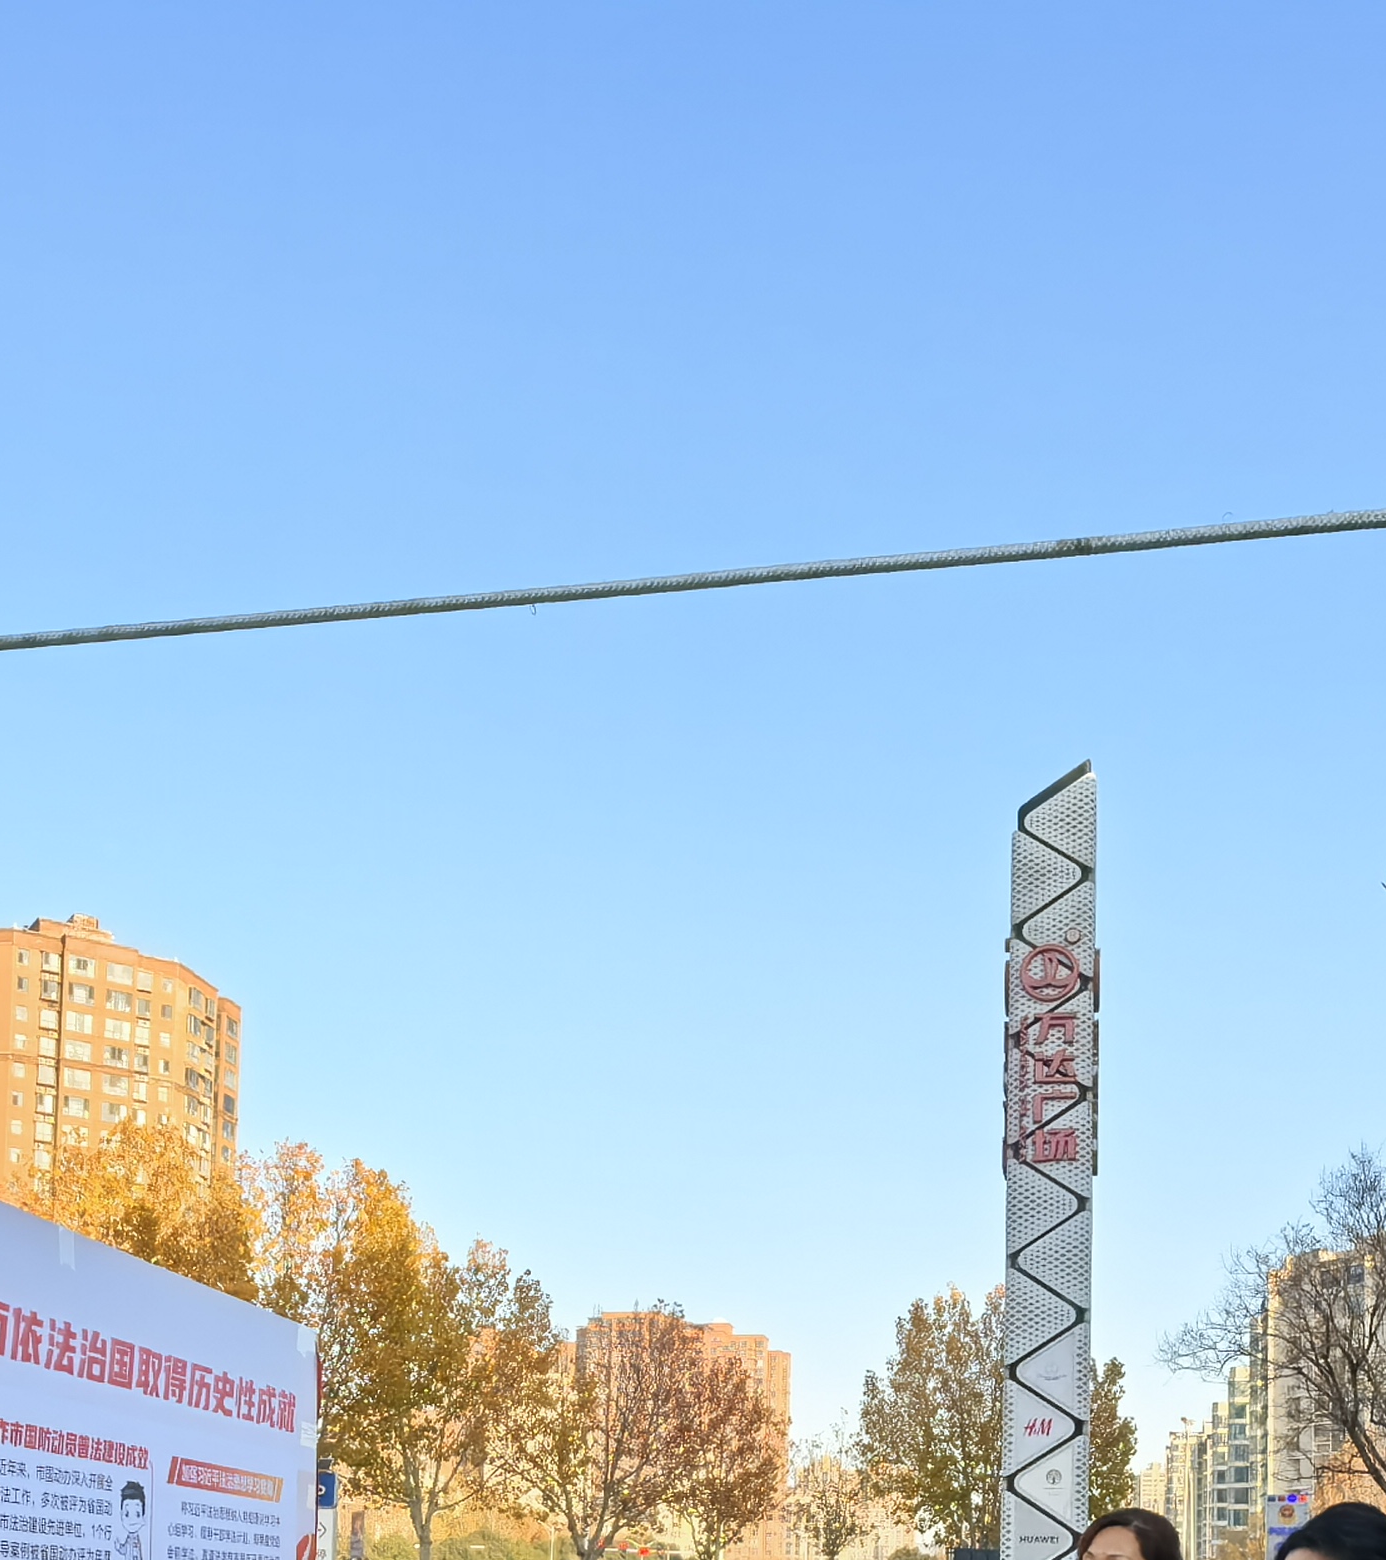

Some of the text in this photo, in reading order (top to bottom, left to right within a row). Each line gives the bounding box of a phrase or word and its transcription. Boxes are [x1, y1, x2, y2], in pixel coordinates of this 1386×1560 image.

[1033, 1013, 1079, 1163] 万达广场
[1023, 1418, 1053, 1437] H&M
[1018, 1535, 1060, 1545] HUAWEI
